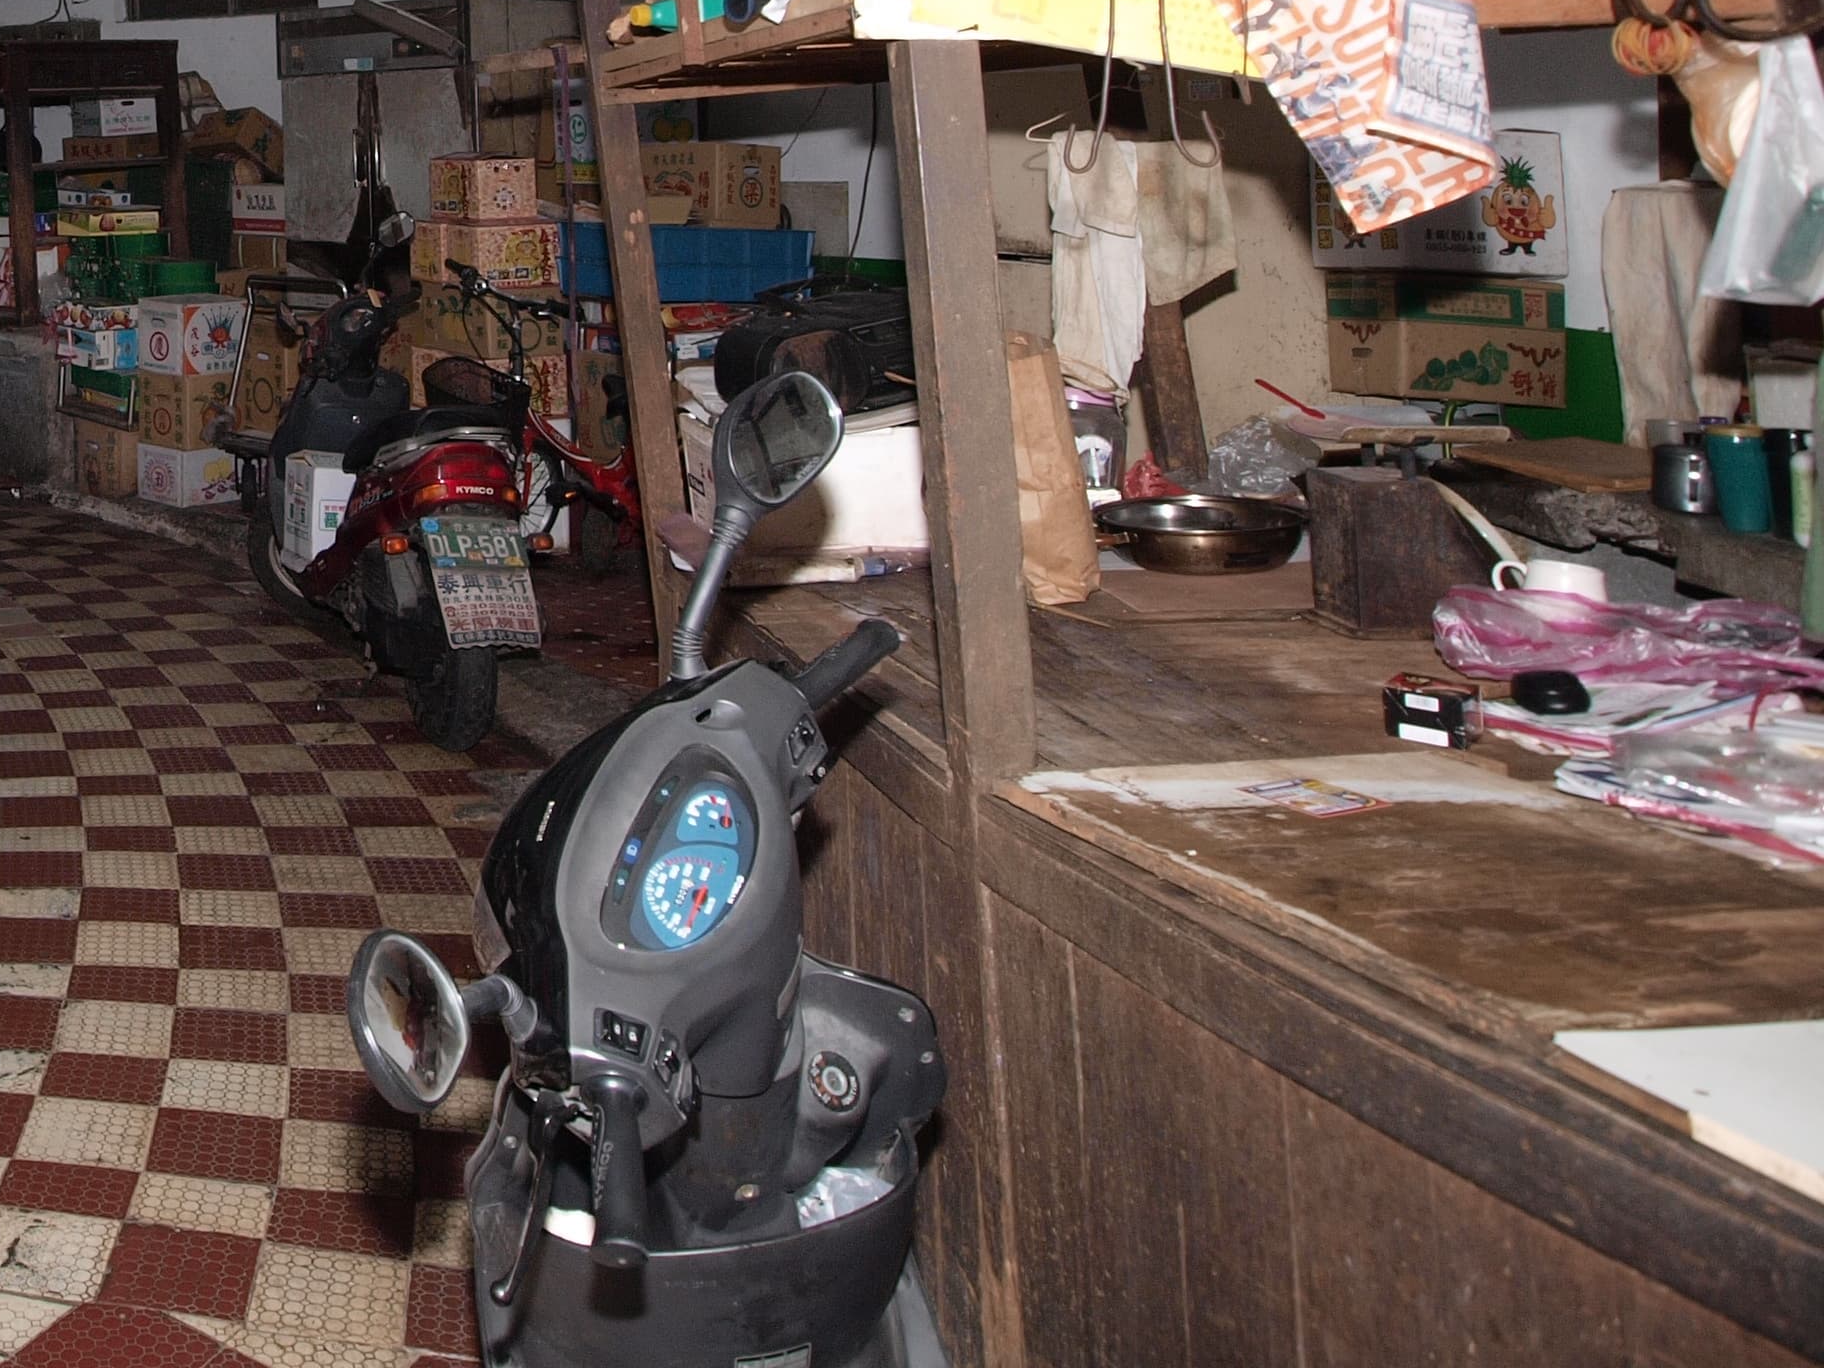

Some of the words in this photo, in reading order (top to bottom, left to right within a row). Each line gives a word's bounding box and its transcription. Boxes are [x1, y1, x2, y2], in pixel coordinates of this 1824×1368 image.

[455, 485, 495, 496] KYMCO
[427, 533, 521, 559] DLP-581
[437, 573, 528, 595] 泰興車行
